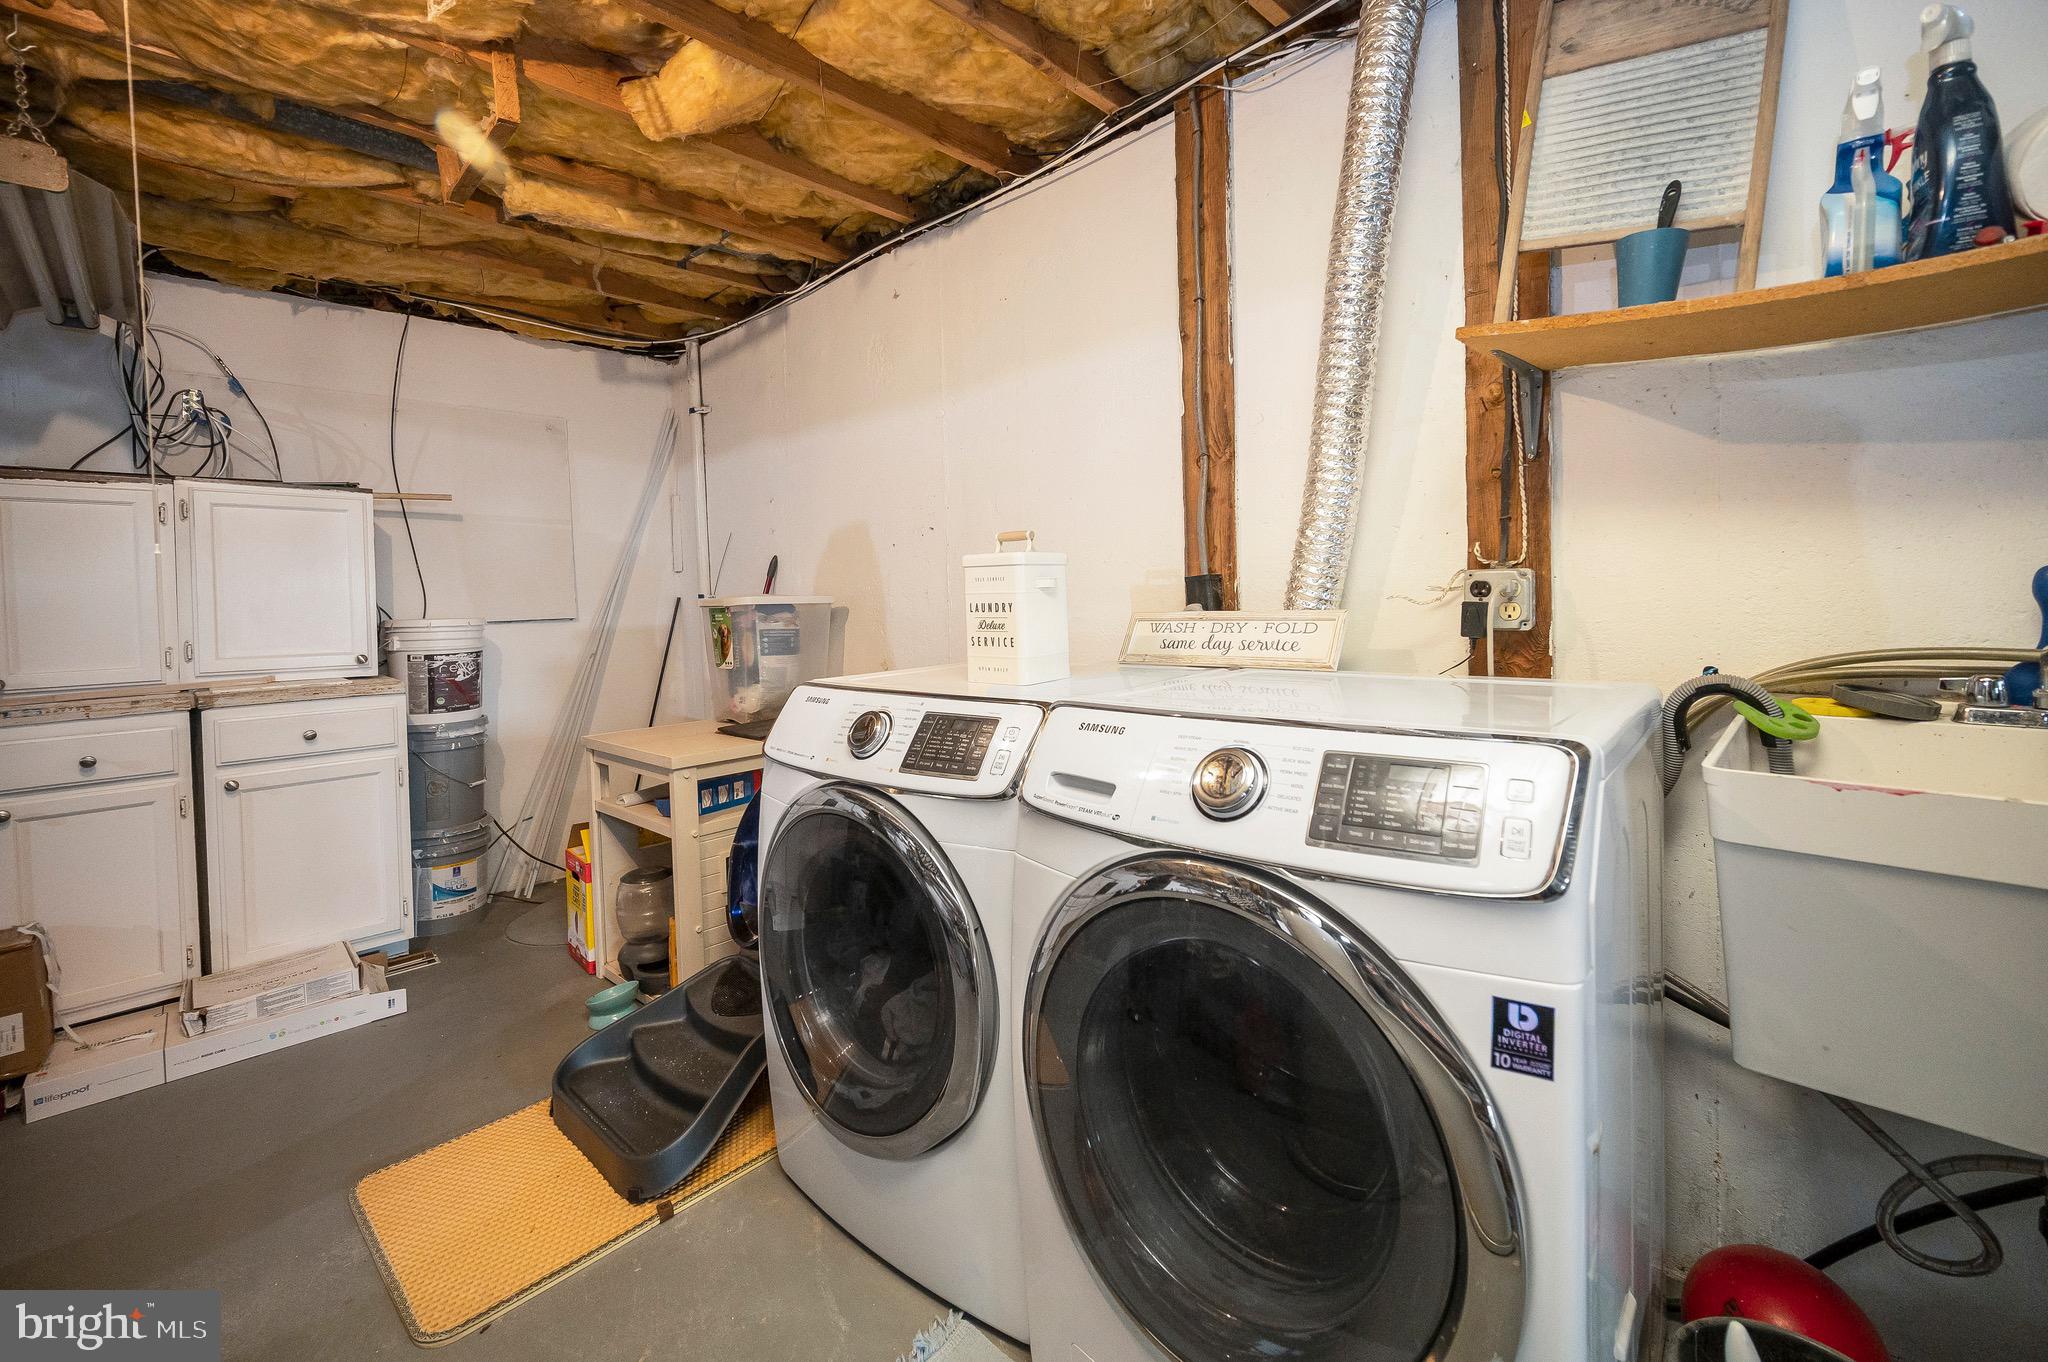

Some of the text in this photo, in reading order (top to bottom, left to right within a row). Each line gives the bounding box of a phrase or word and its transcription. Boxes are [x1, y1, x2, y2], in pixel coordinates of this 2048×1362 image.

[969, 602, 1013, 613] LAUNDRY
[977, 619, 1006, 631] Deluxe
[1150, 622, 1319, 635] WASH DRY FOLD
[970, 636, 1015, 648] SERVICE
[1159, 634, 1302, 656] same day service
[805, 695, 831, 705] SAMSUNG
[1078, 721, 1126, 736] SAMSUNG
[1502, 1027, 1543, 1044] DIGITAL
[1497, 1034, 1549, 1053] INVERTER
[1493, 1051, 1512, 1069] 10
[44, 1083, 92, 1104] lifeproof
